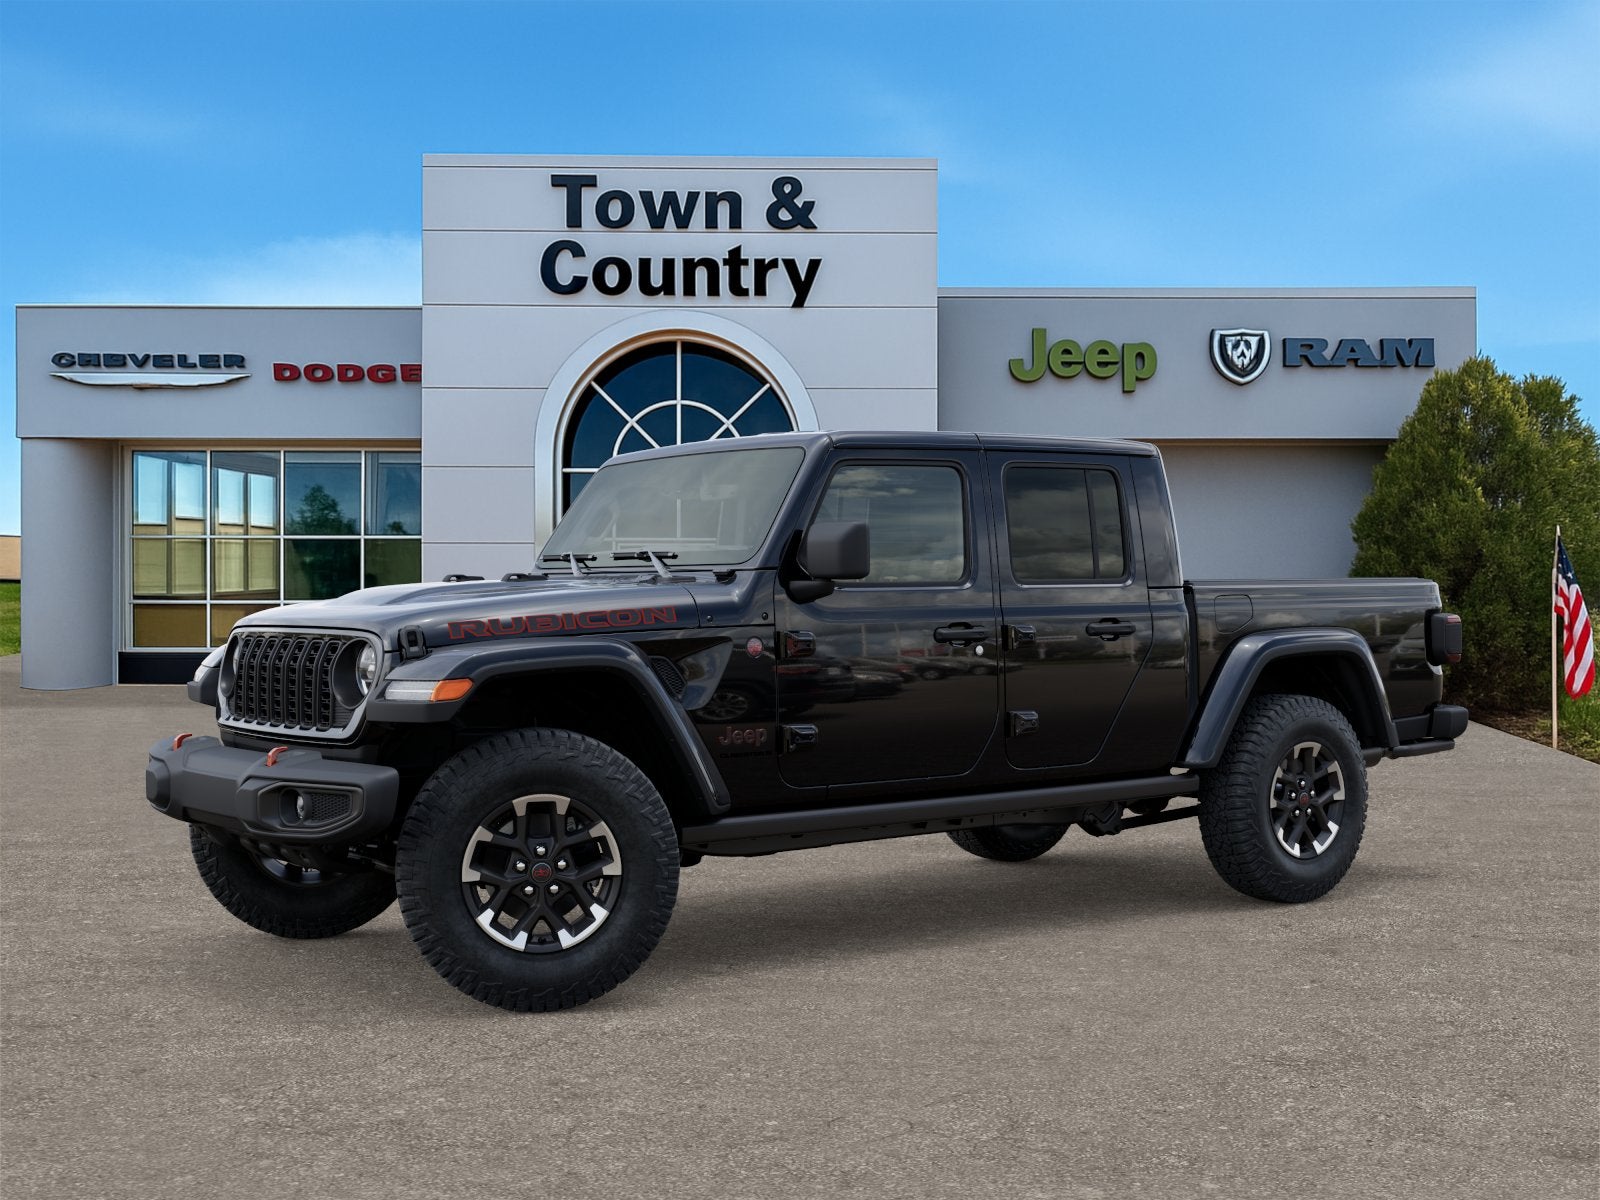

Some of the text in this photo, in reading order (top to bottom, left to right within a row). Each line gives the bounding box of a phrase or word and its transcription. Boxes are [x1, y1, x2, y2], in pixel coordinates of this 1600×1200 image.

[550, 174, 818, 229] Town &
[540, 239, 822, 308] Country
[1009, 327, 1158, 392] Jeep
[1282, 337, 1436, 367] RAM
[273, 362, 422, 383] DODGE
[448, 606, 678, 639] RUBICON
[717, 726, 768, 746] Jeep
